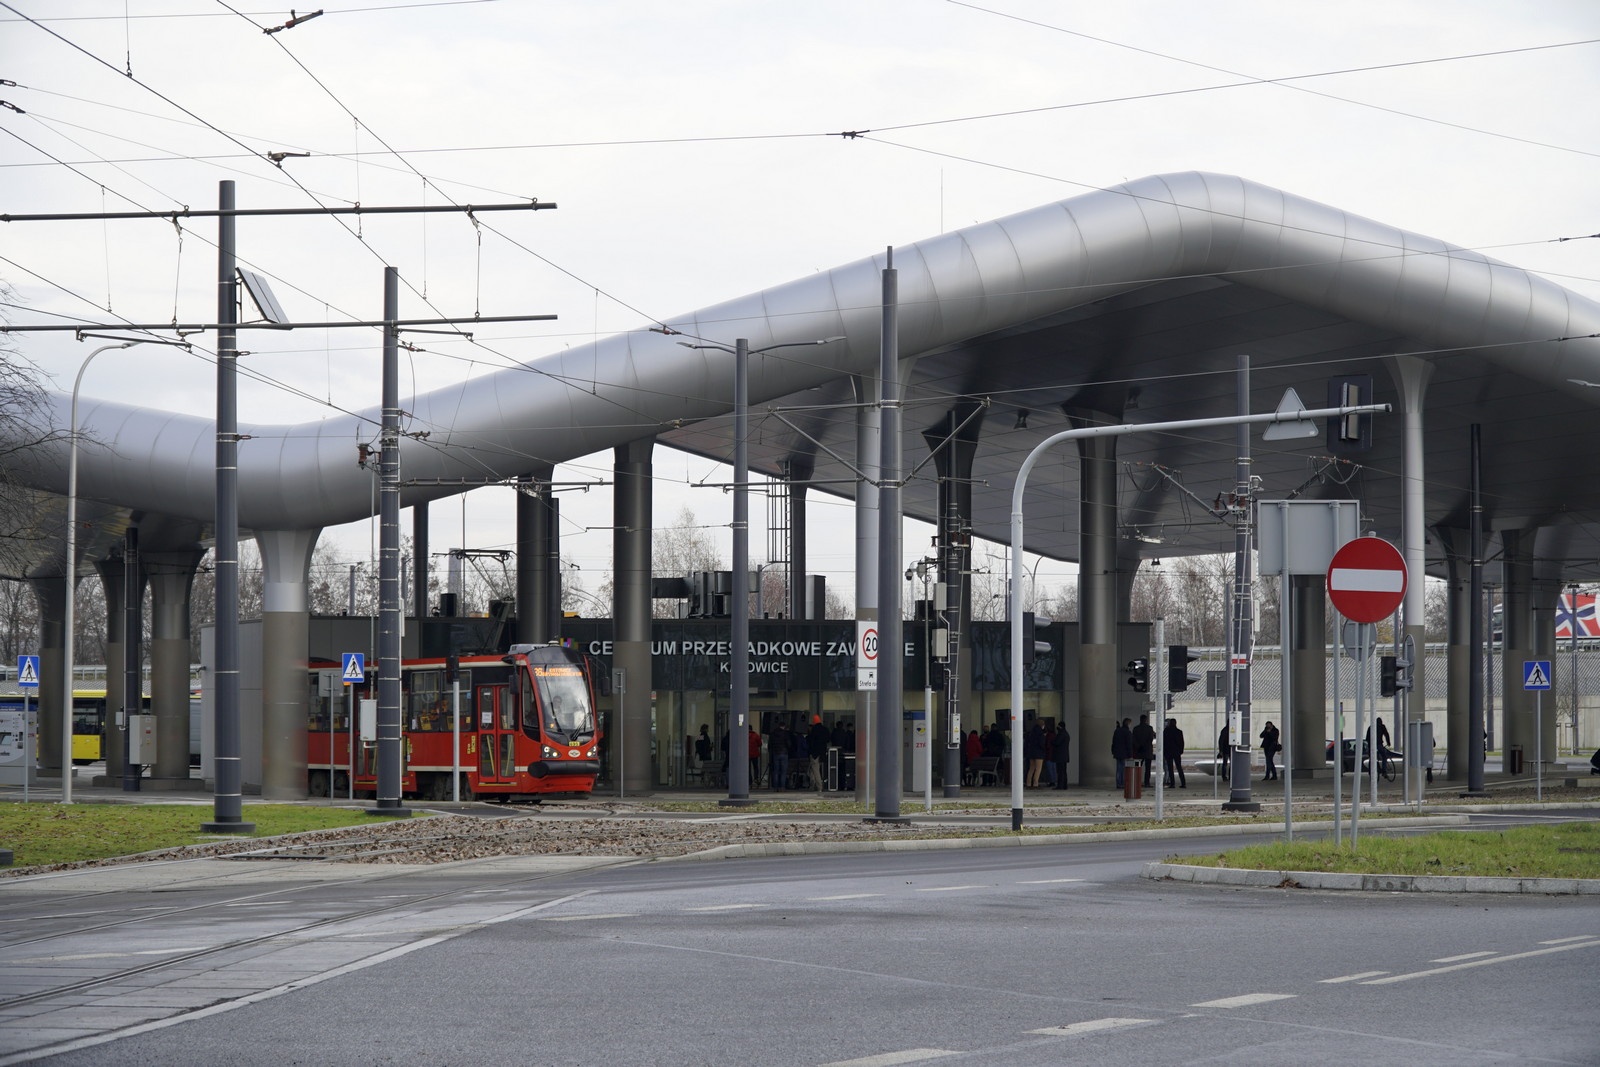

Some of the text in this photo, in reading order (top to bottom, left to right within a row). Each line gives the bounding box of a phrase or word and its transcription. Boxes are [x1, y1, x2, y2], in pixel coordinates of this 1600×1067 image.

[589, 641, 676, 655] CEUM
[865, 637, 877, 652] 20
[720, 662, 789, 673] KOWICE
